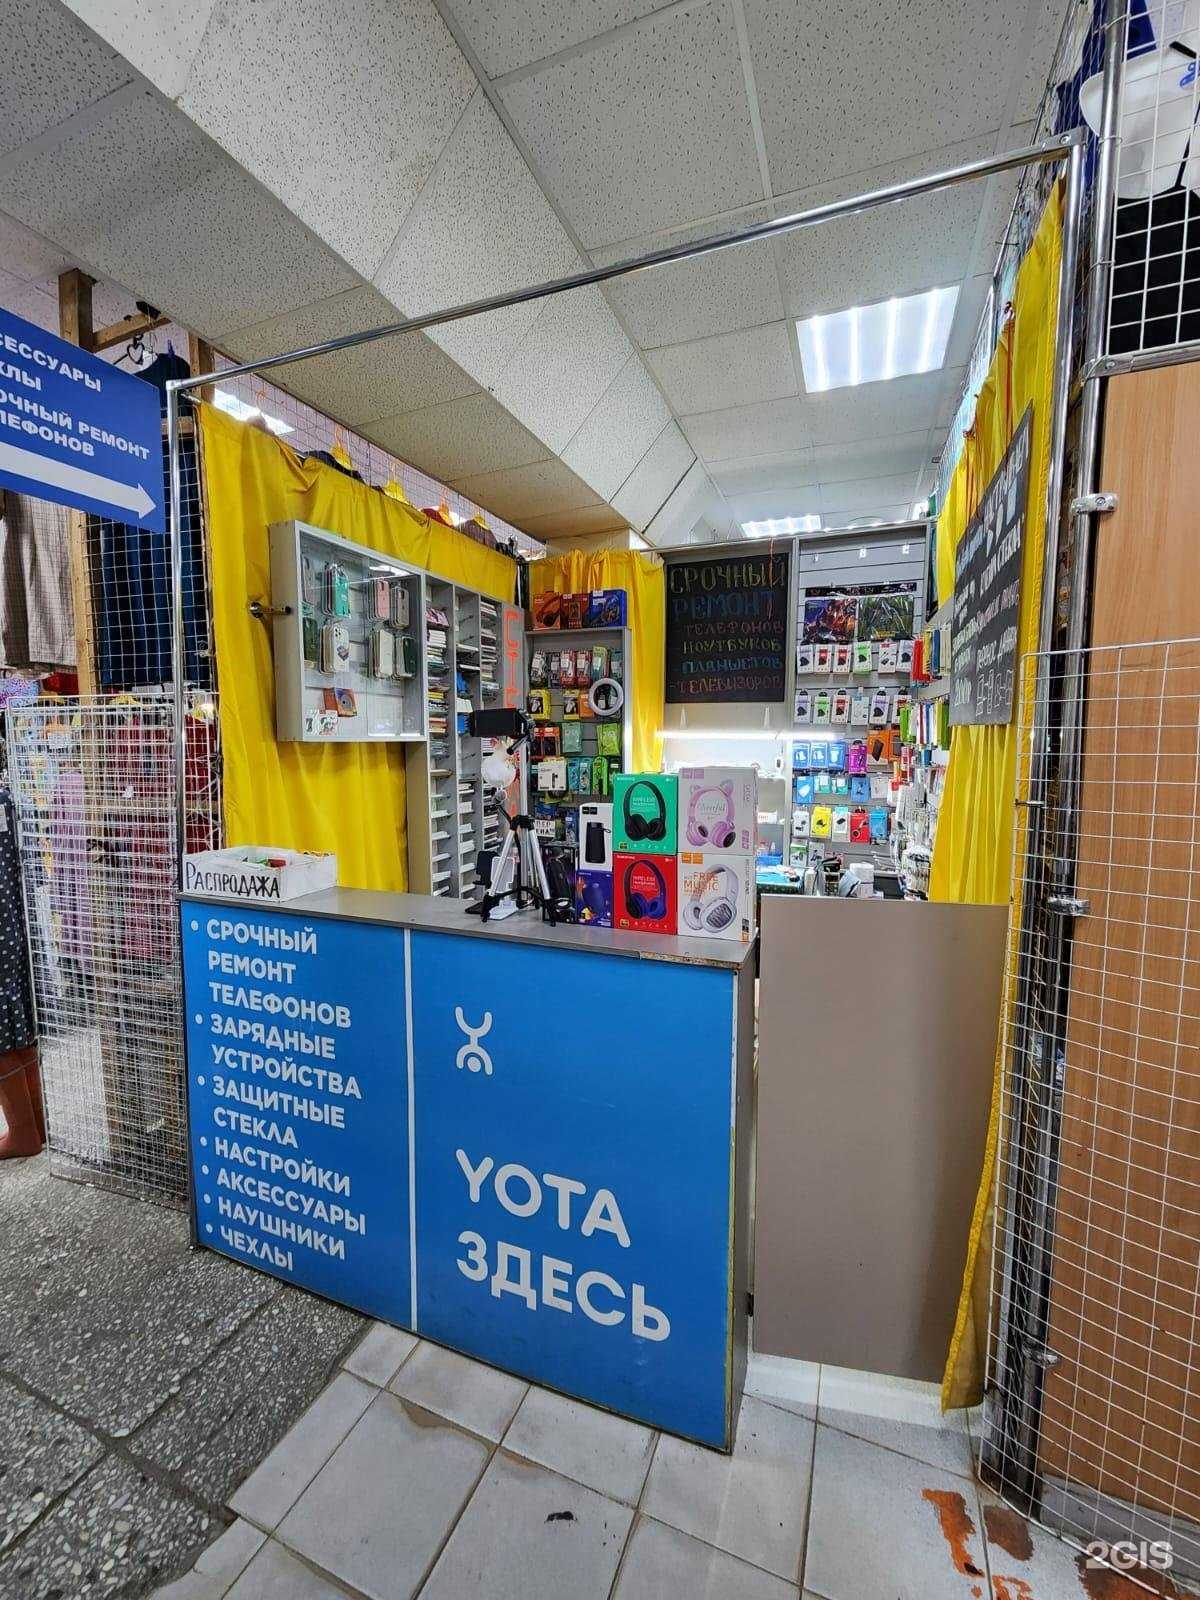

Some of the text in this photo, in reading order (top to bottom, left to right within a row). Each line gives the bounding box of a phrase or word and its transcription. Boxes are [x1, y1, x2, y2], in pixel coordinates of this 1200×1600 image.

[0, 333, 102, 392] ЕССУАРЫ
[78, 420, 150, 460] РЕМОНТ
[671, 557, 785, 594] СРОЧНЫЙ
[672, 587, 775, 622] РЕМОНТ
[682, 638, 782, 655] НОУТБУКОВ
[685, 621, 784, 636] ТЕЛЕФОНОВ
[681, 656, 782, 674] ПЛАНШЕТОВ
[207, 918, 317, 954] СРОЧНЫЙ
[208, 951, 296, 984] РЕМОНТ
[209, 982, 351, 1028] ТЕЛЕФОНОВ
[210, 1013, 336, 1060] ЗАРЯДНЫЕ
[211, 1044, 362, 1099] УСТРОЙСТВА
[213, 1075, 345, 1128] ЗАЩИТНЫЕ
[213, 1107, 299, 1148] СТЕКЛА
[215, 1136, 350, 1197] НАСТРОЙКИ
[217, 1168, 366, 1235] АКСЕССУАРЫ
[456, 1149, 631, 1248] YOTA
[218, 1196, 345, 1260] НАУШНИКИ
[221, 1225, 293, 1271] ЧЕХЛЫ
[456, 1230, 671, 1342] ЗДЕСЬ
